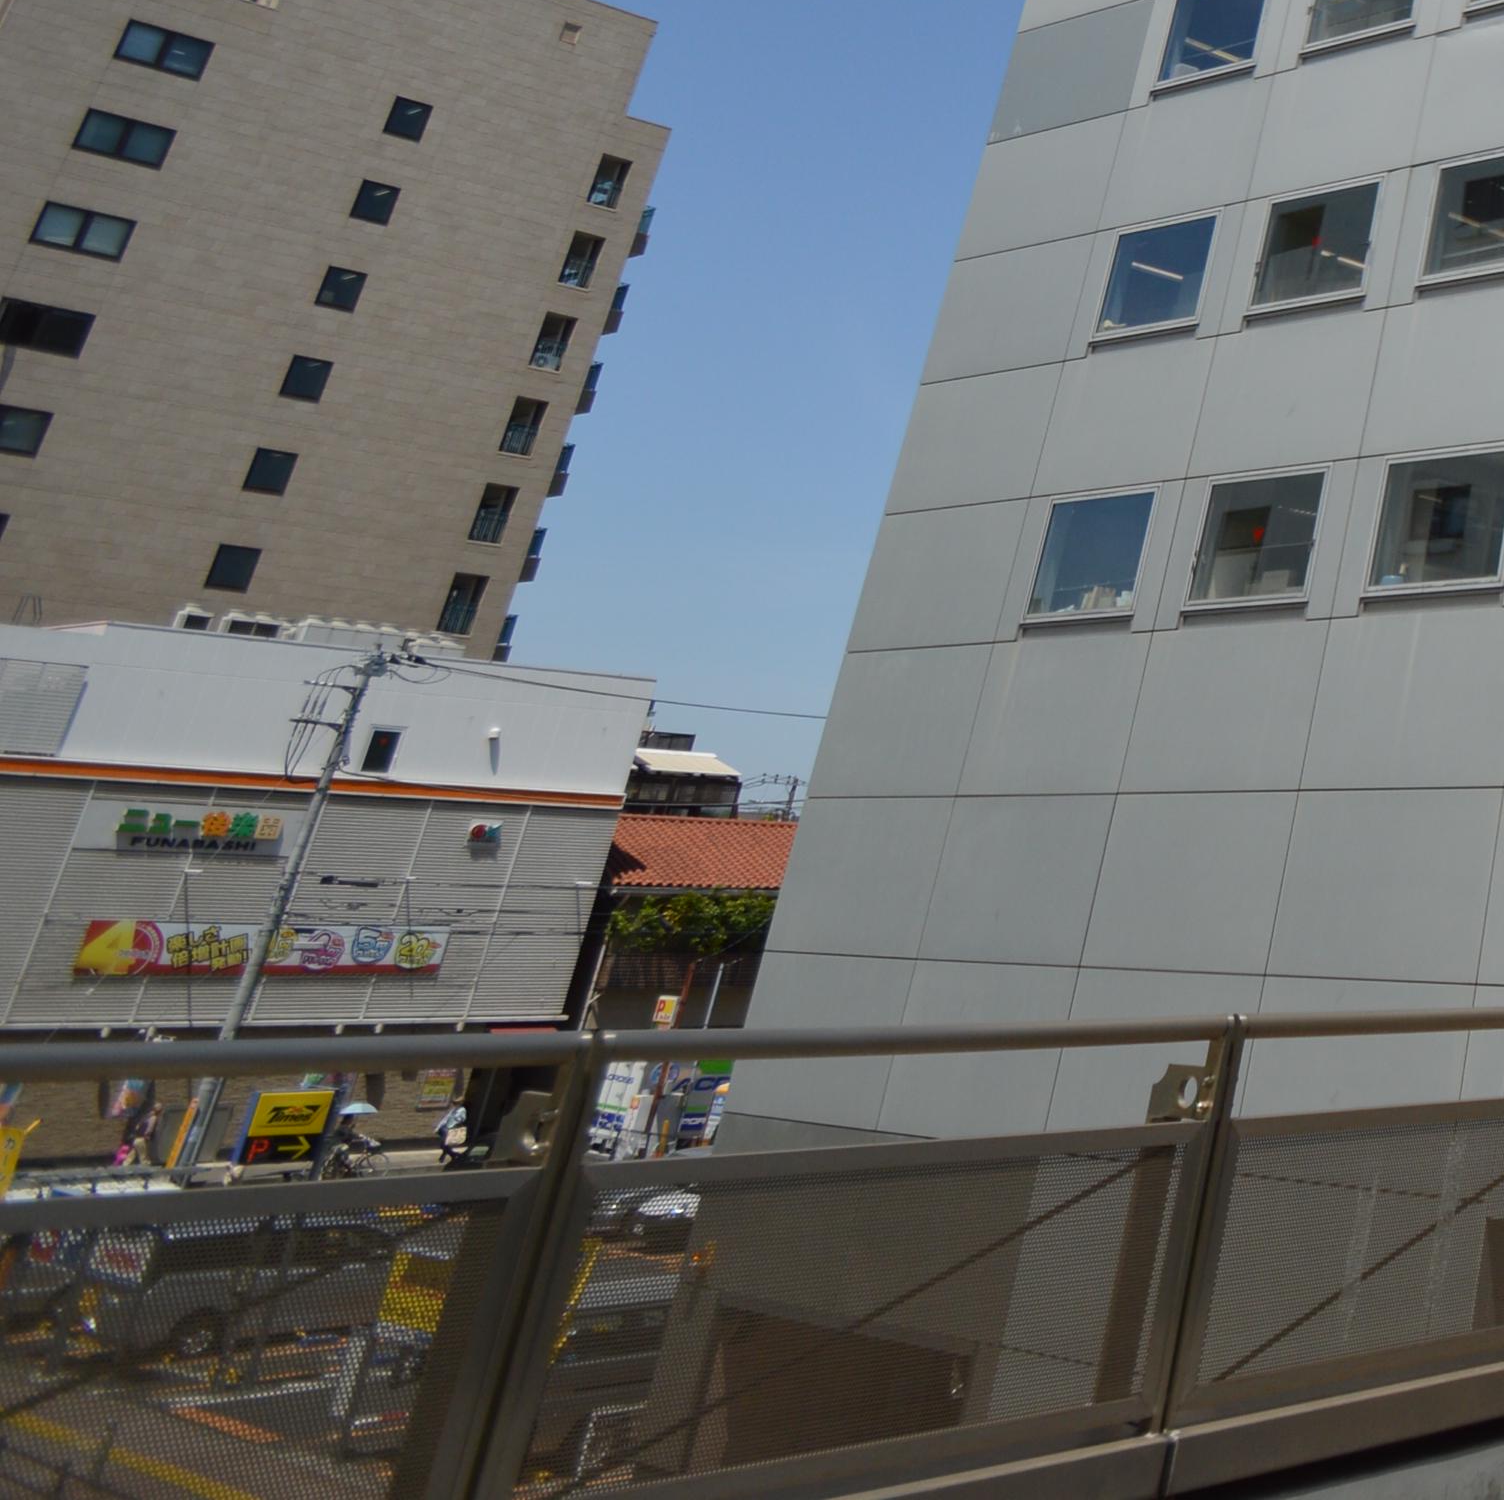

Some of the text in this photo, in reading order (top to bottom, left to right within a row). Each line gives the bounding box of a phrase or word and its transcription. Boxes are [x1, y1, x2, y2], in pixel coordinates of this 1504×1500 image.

[130, 836, 256, 852] FUNABASHI
[268, 1105, 321, 1124] Times
[247, 1138, 270, 1164] P
